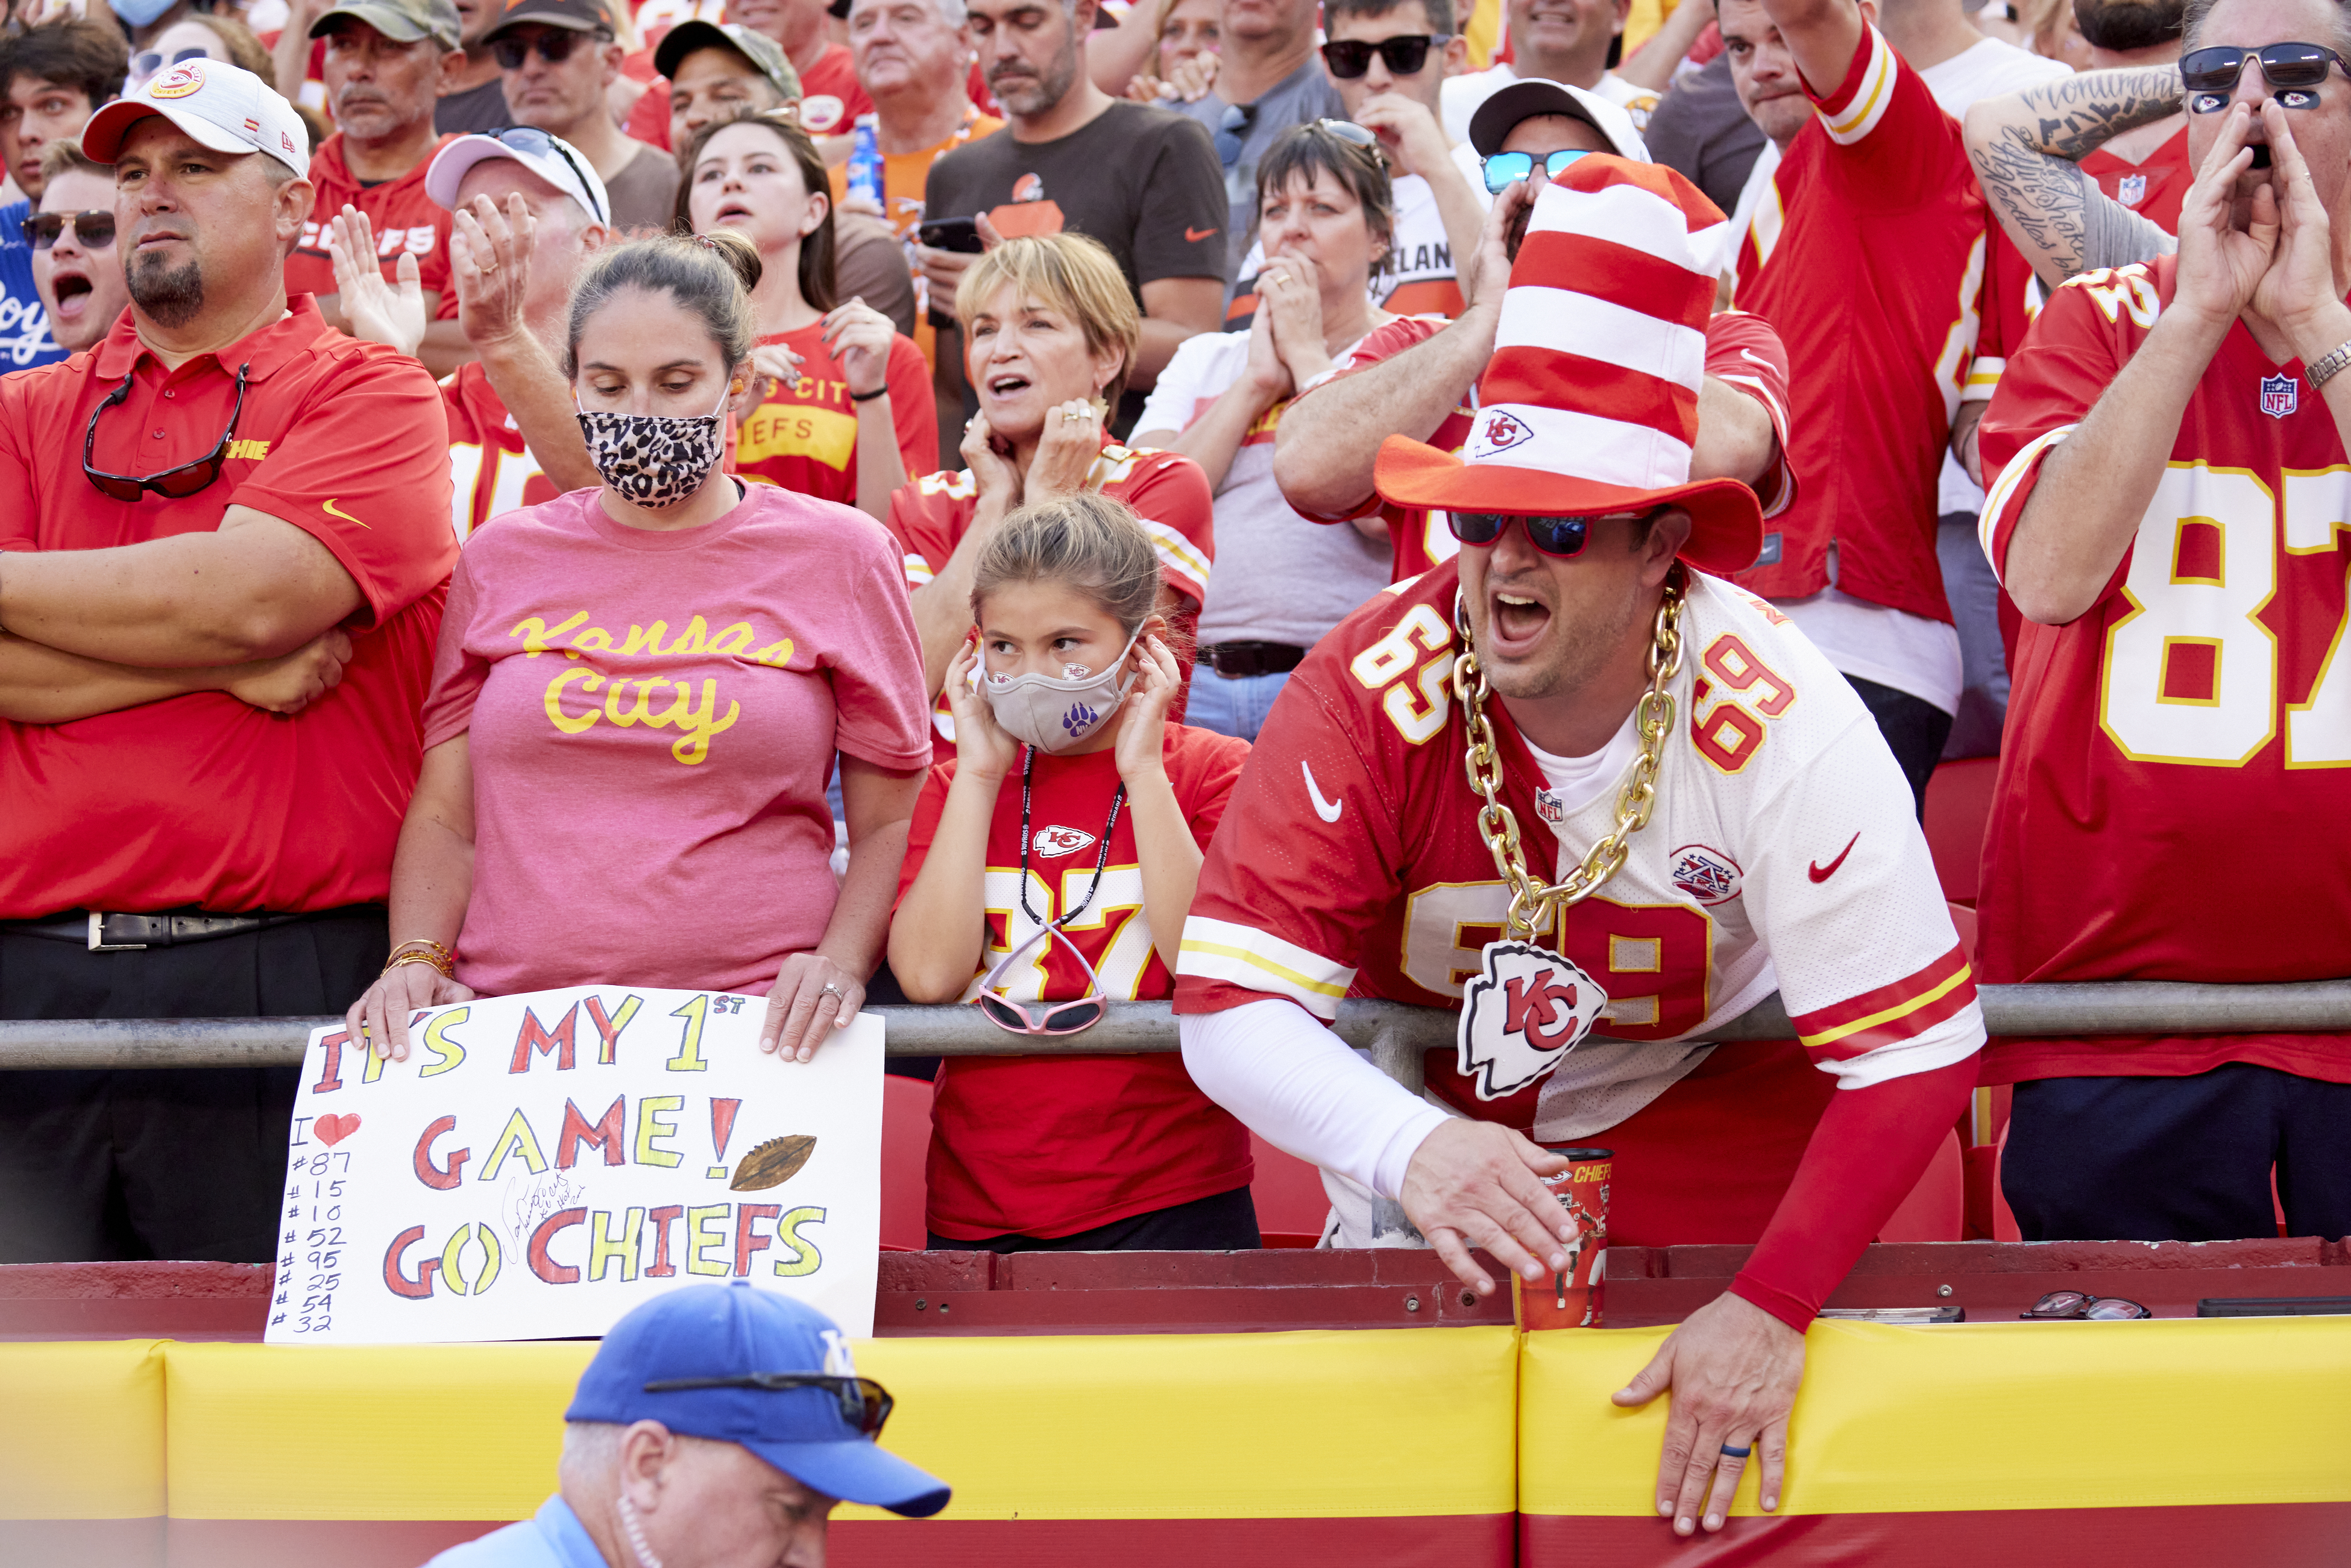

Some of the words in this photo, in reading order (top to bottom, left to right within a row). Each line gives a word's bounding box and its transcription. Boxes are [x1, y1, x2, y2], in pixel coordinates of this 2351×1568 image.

[795, 376, 858, 410] CIT
[2266, 394, 2292, 411] NFL
[1485, 417, 1517, 446] KC
[509, 610, 795, 667] Kansas
[2099, 459, 2351, 770] 87
[544, 667, 740, 765] City
[1690, 631, 1798, 776] 69
[1540, 801, 1561, 820] NFL
[1048, 831, 1081, 848] KC
[1400, 875, 1713, 1041] 69
[508, 993, 643, 1074] MY
[1503, 968, 1578, 1053] KC
[291, 1116, 313, 1147] I
[1573, 1162, 1612, 1183] CHIEFS
[383, 1221, 502, 1300] GO
[527, 1204, 826, 1284] CHIEFS
